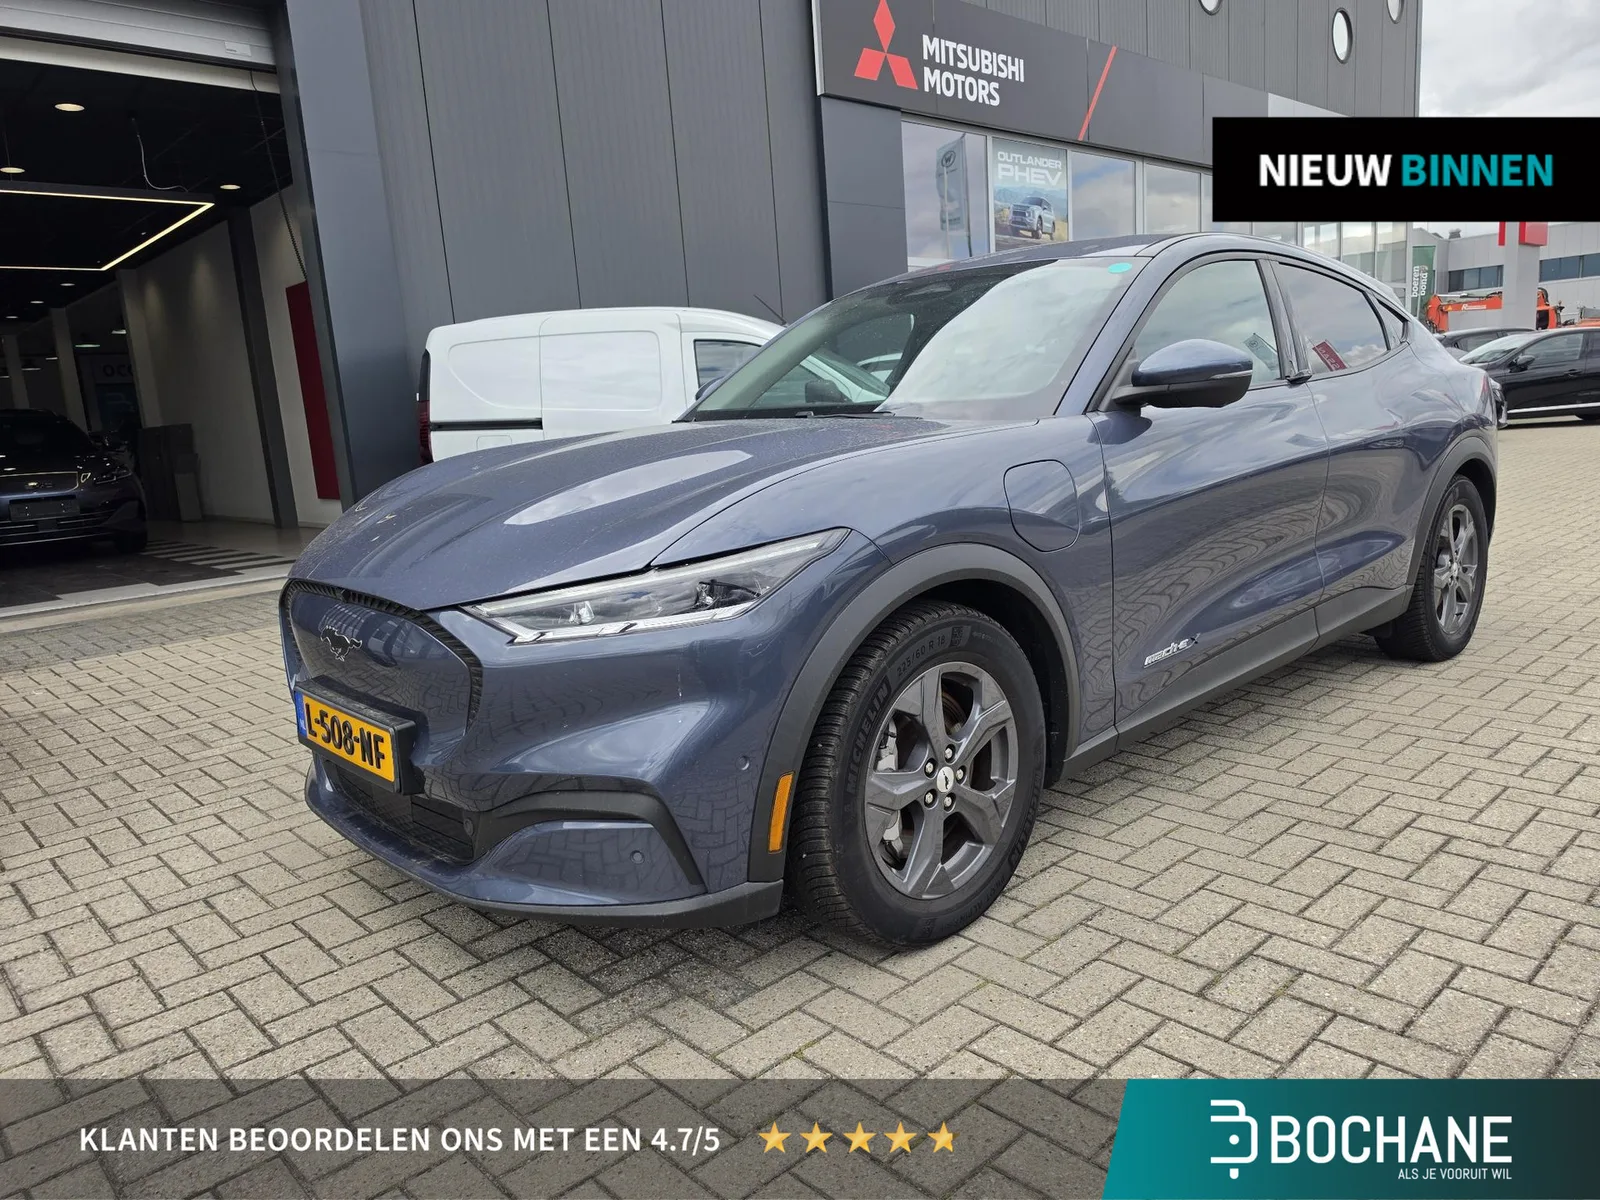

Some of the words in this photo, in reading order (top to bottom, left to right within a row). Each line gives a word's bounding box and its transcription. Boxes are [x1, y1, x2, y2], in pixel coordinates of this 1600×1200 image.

[922, 34, 1025, 83] MITSUBISHI
[923, 67, 1000, 107] MOTORS
[997, 151, 1062, 170] OUTLANDER
[997, 162, 1062, 186] PHEV
[1411, 265, 1420, 298] boeren
[896, 644, 926, 677] 225/60
[928, 640, 935, 650] R
[305, 704, 385, 769] L-508-NF
[846, 677, 890, 794] MICHELIN
